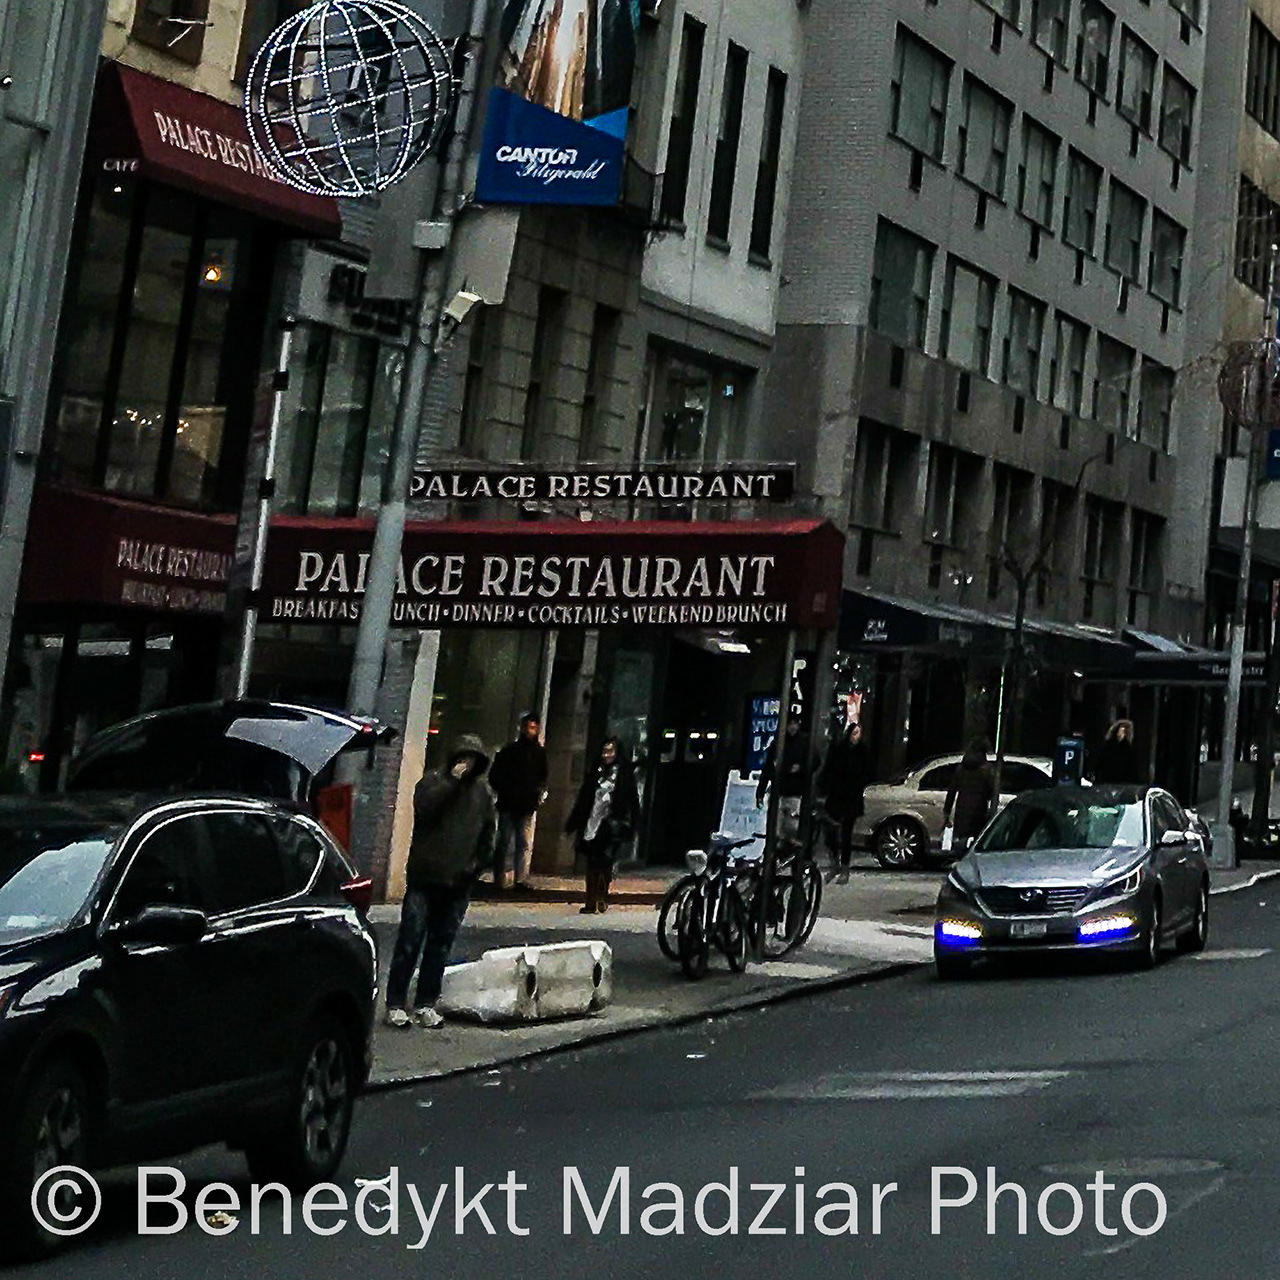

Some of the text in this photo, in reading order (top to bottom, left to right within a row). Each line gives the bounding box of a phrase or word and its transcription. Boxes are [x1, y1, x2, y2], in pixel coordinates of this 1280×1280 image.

[154, 109, 217, 161] PALACE
[409, 474, 776, 498] PALACE RESTAURANT
[479, 554, 775, 598] RESTAURANT
[272, 598, 788, 624] BREAKFAS UNCH DINNER COCKTAILS WEEKEND BRUNCH
[1064, 750, 1075, 765] P
